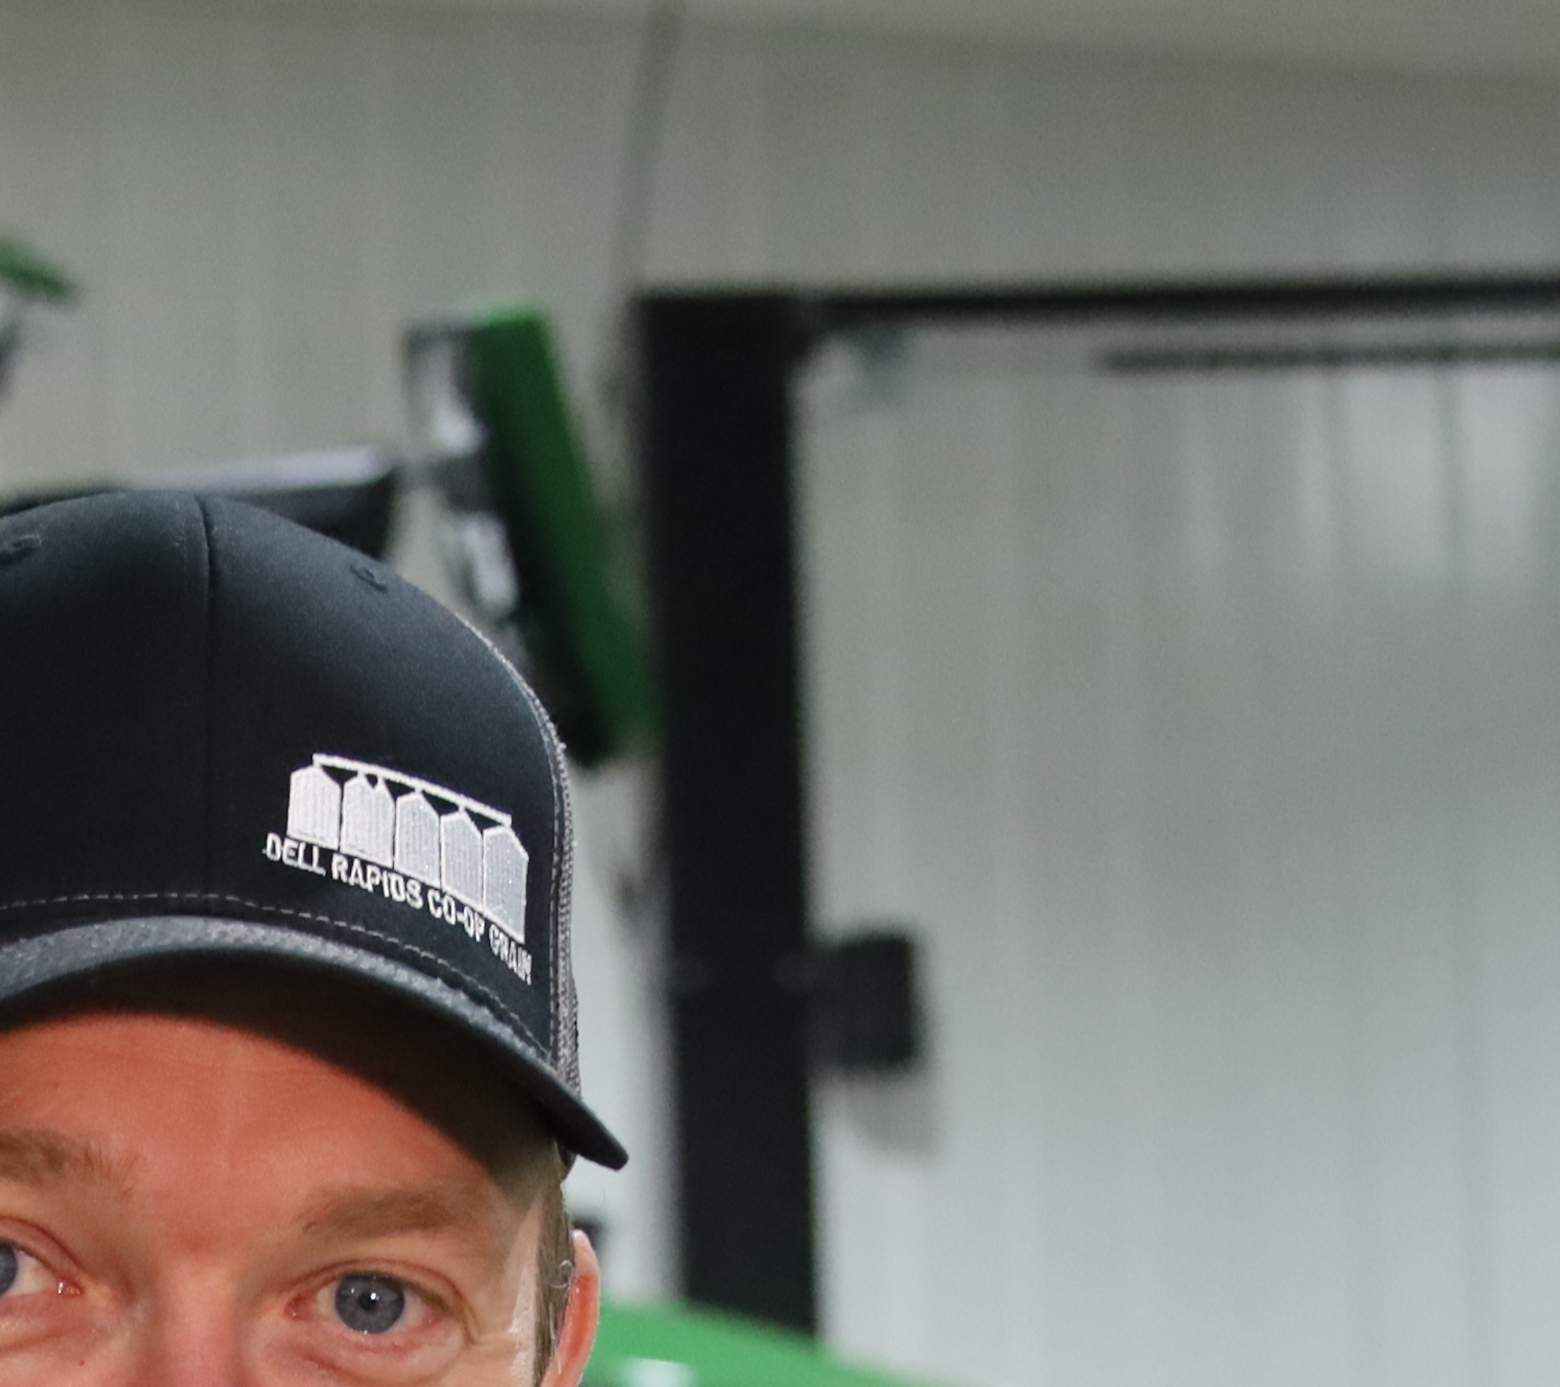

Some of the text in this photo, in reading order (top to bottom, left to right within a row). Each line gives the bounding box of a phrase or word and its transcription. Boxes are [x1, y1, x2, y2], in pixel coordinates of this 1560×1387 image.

[262, 832, 533, 986] DELL RAPIDS CO-OP GRAIN
